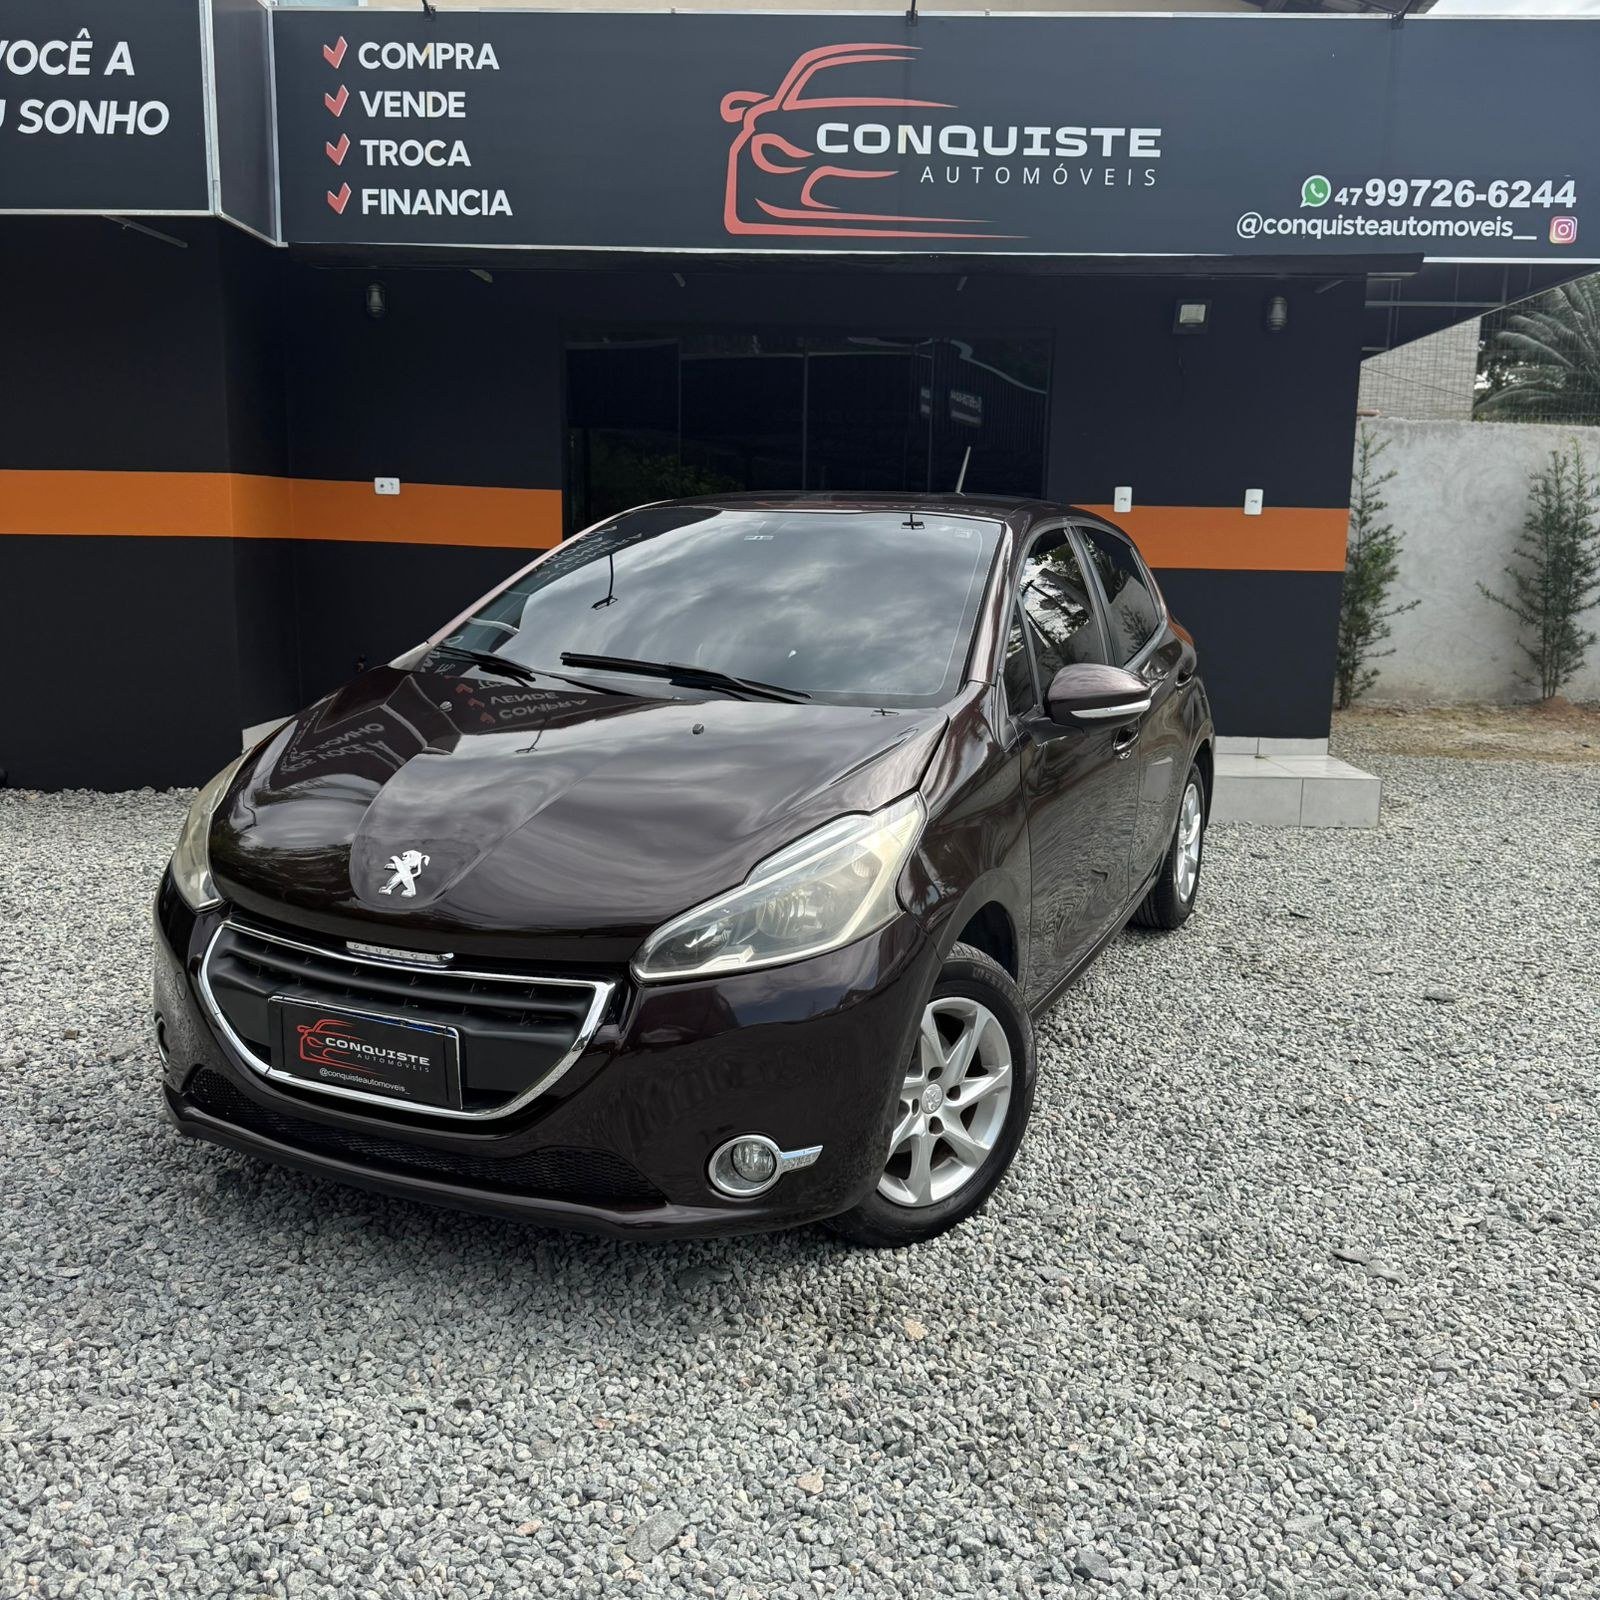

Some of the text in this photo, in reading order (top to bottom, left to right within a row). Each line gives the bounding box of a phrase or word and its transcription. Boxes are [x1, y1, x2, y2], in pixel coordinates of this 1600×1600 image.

[103, 41, 135, 76] A
[358, 41, 500, 71] COMPRA
[17, 98, 170, 136] SONHO
[359, 90, 466, 119] VENDE
[359, 139, 471, 167] TROCA
[816, 122, 1162, 158] CONQUISTE
[920, 163, 1157, 187] AUTOMÓVEIS
[361, 188, 513, 217] FINANCIA
[325, 1037, 431, 1066] CONQUISTE
